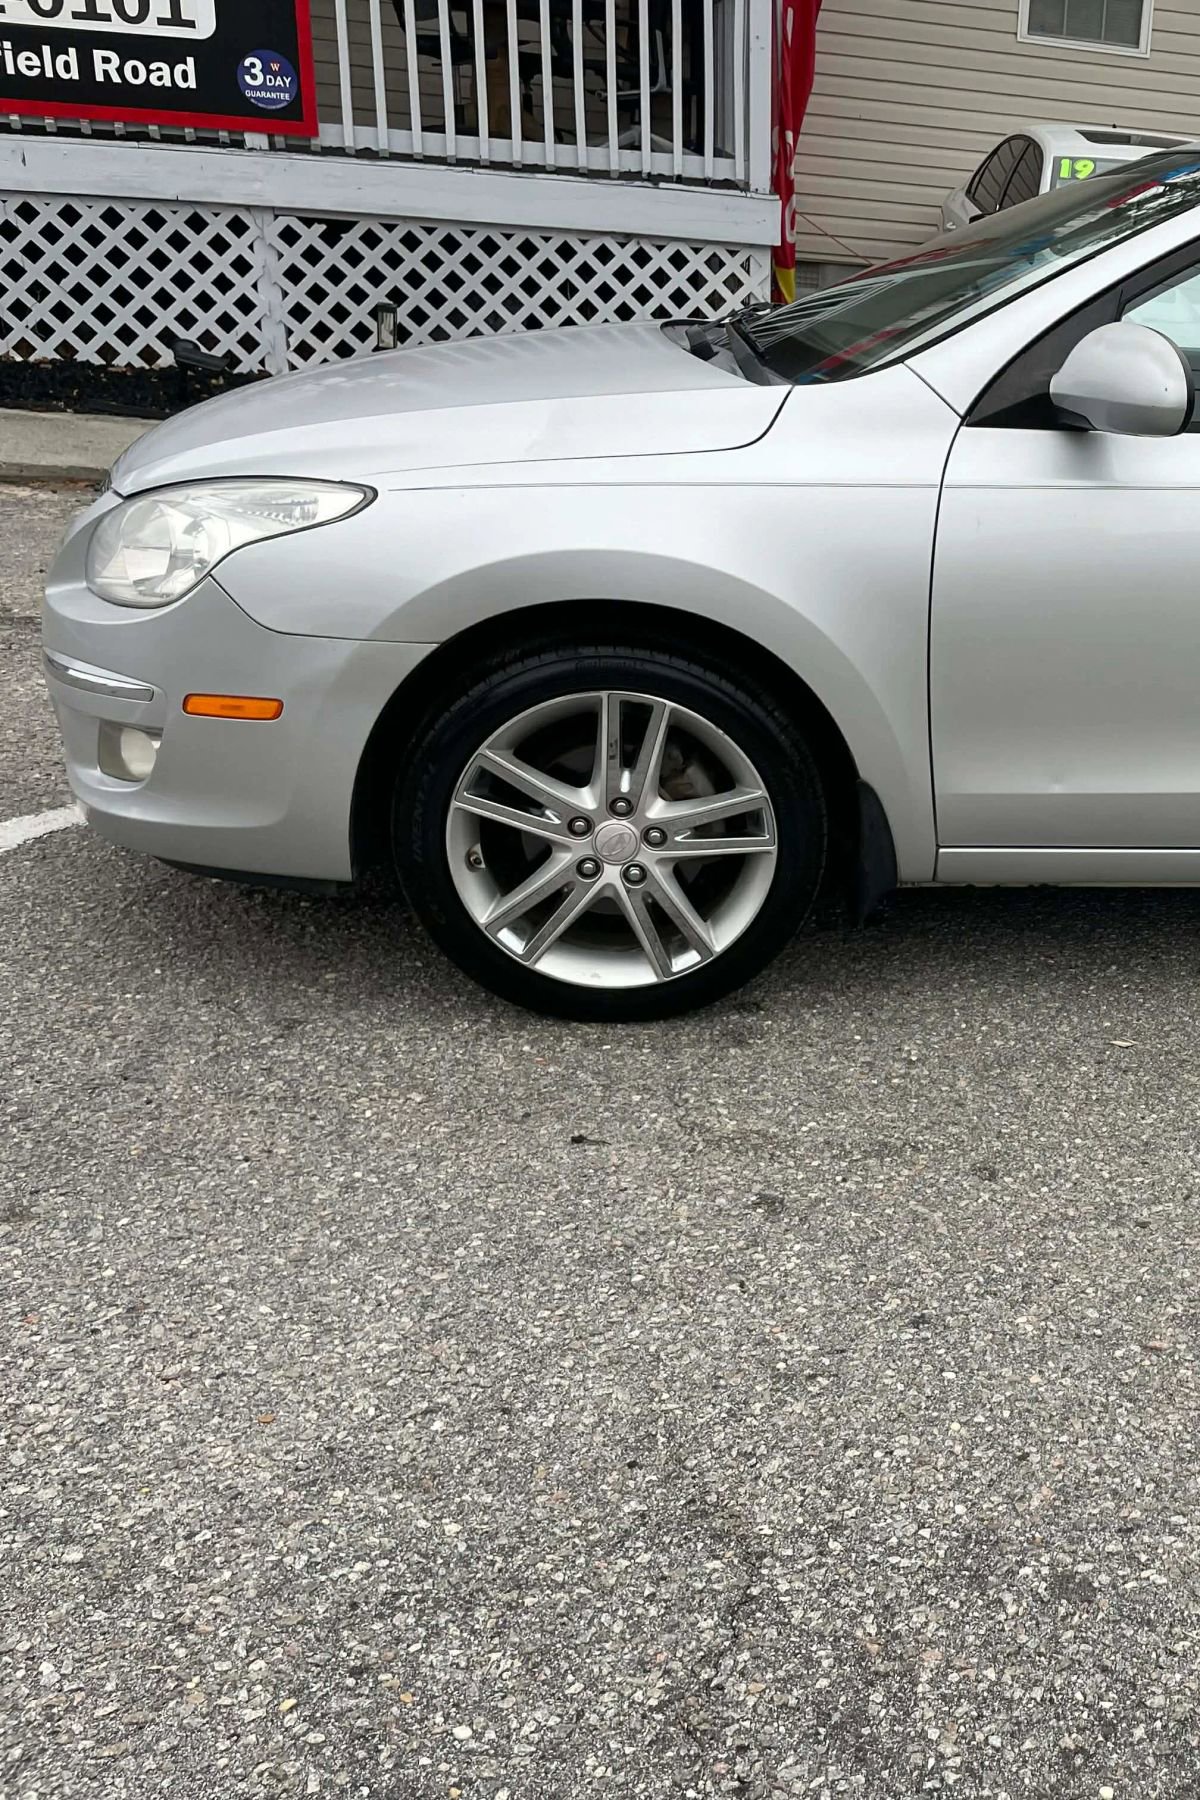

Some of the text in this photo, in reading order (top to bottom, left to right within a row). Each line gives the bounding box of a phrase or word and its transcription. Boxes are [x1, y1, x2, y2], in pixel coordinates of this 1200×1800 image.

[0, 40, 196, 89] ield Road
[244, 56, 291, 88] 3 DAY
[245, 89, 290, 101] GUARANTEE
[1060, 158, 1095, 180] 19
